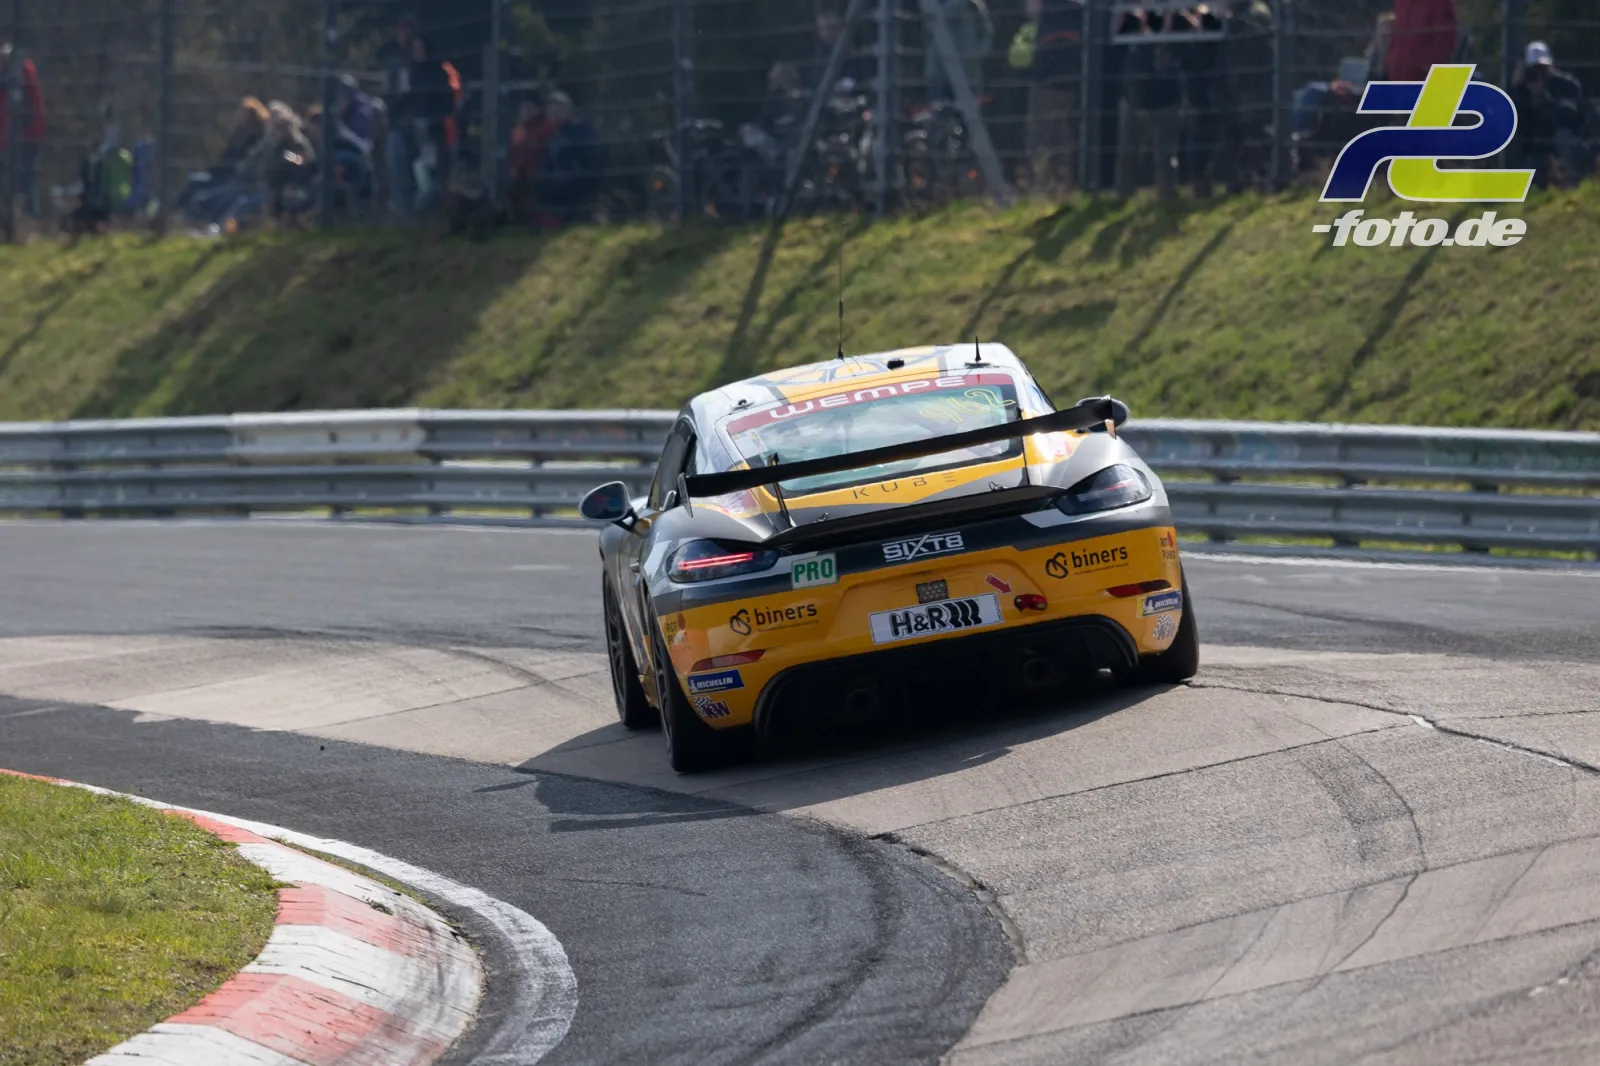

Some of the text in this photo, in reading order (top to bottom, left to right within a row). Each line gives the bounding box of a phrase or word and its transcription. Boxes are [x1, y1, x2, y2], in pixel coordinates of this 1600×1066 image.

[768, 376, 966, 419] WEMPE
[919, 388, 1016, 424] 962
[852, 472, 957, 500] KUBE
[1071, 546, 1128, 568] biners
[794, 558, 833, 583] PRO
[754, 604, 817, 626] biners
[889, 605, 948, 638] H&R
[696, 676, 734, 688] MICHELIN
